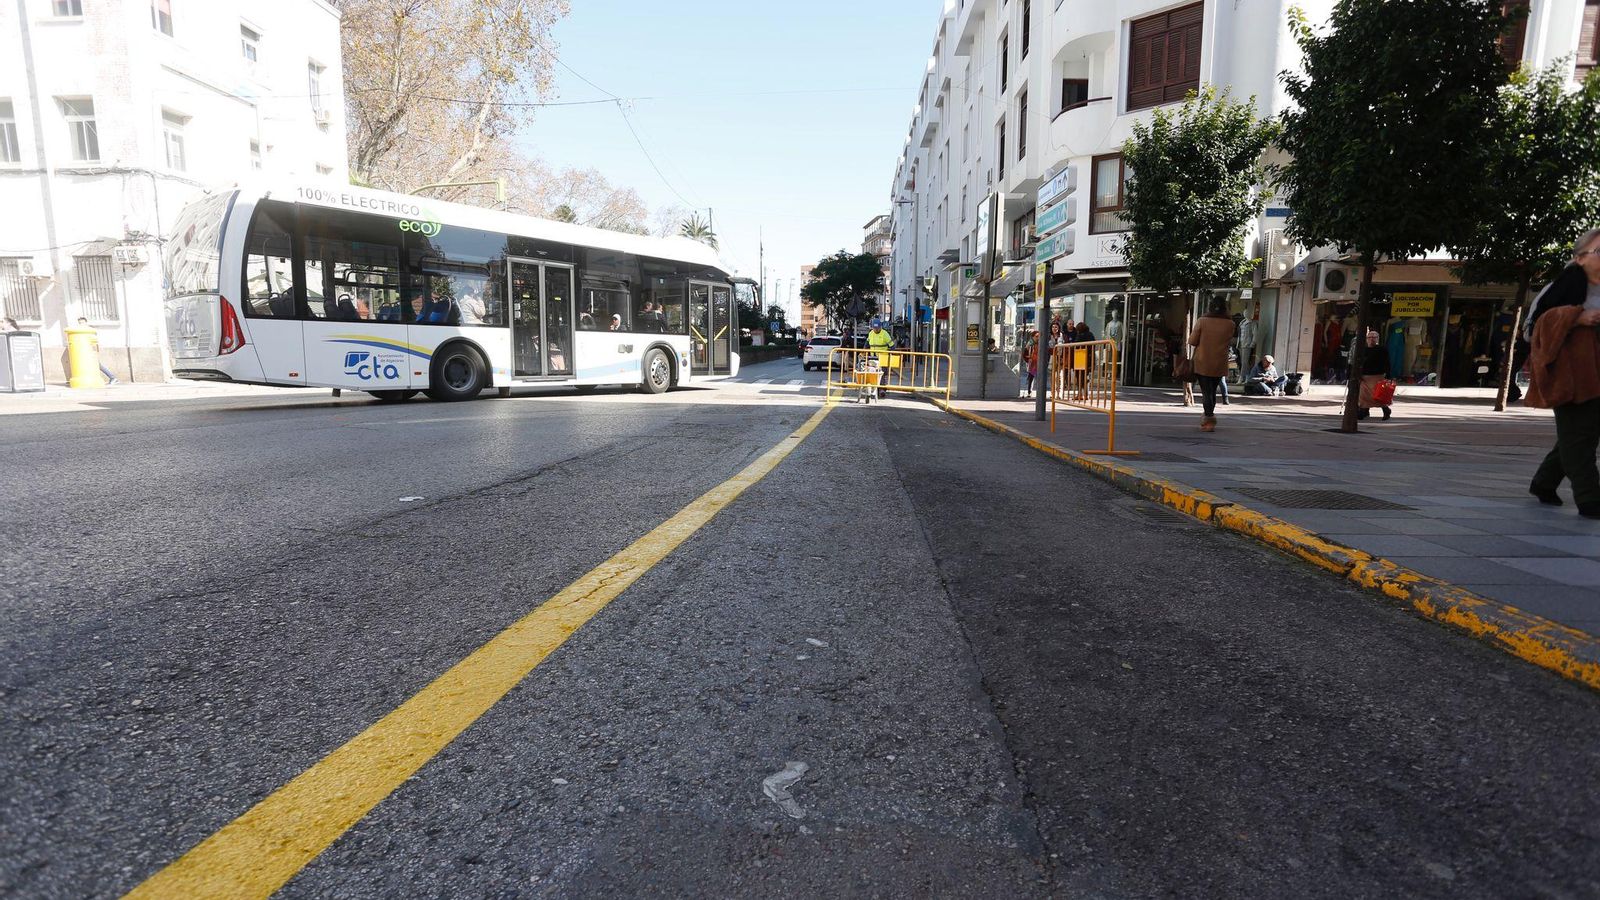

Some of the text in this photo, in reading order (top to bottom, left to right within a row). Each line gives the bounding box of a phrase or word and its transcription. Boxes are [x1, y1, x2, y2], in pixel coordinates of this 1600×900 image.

[297, 187, 420, 216] 100% ELECTRICO
[399, 220, 432, 235] eco
[358, 356, 400, 380] cta
